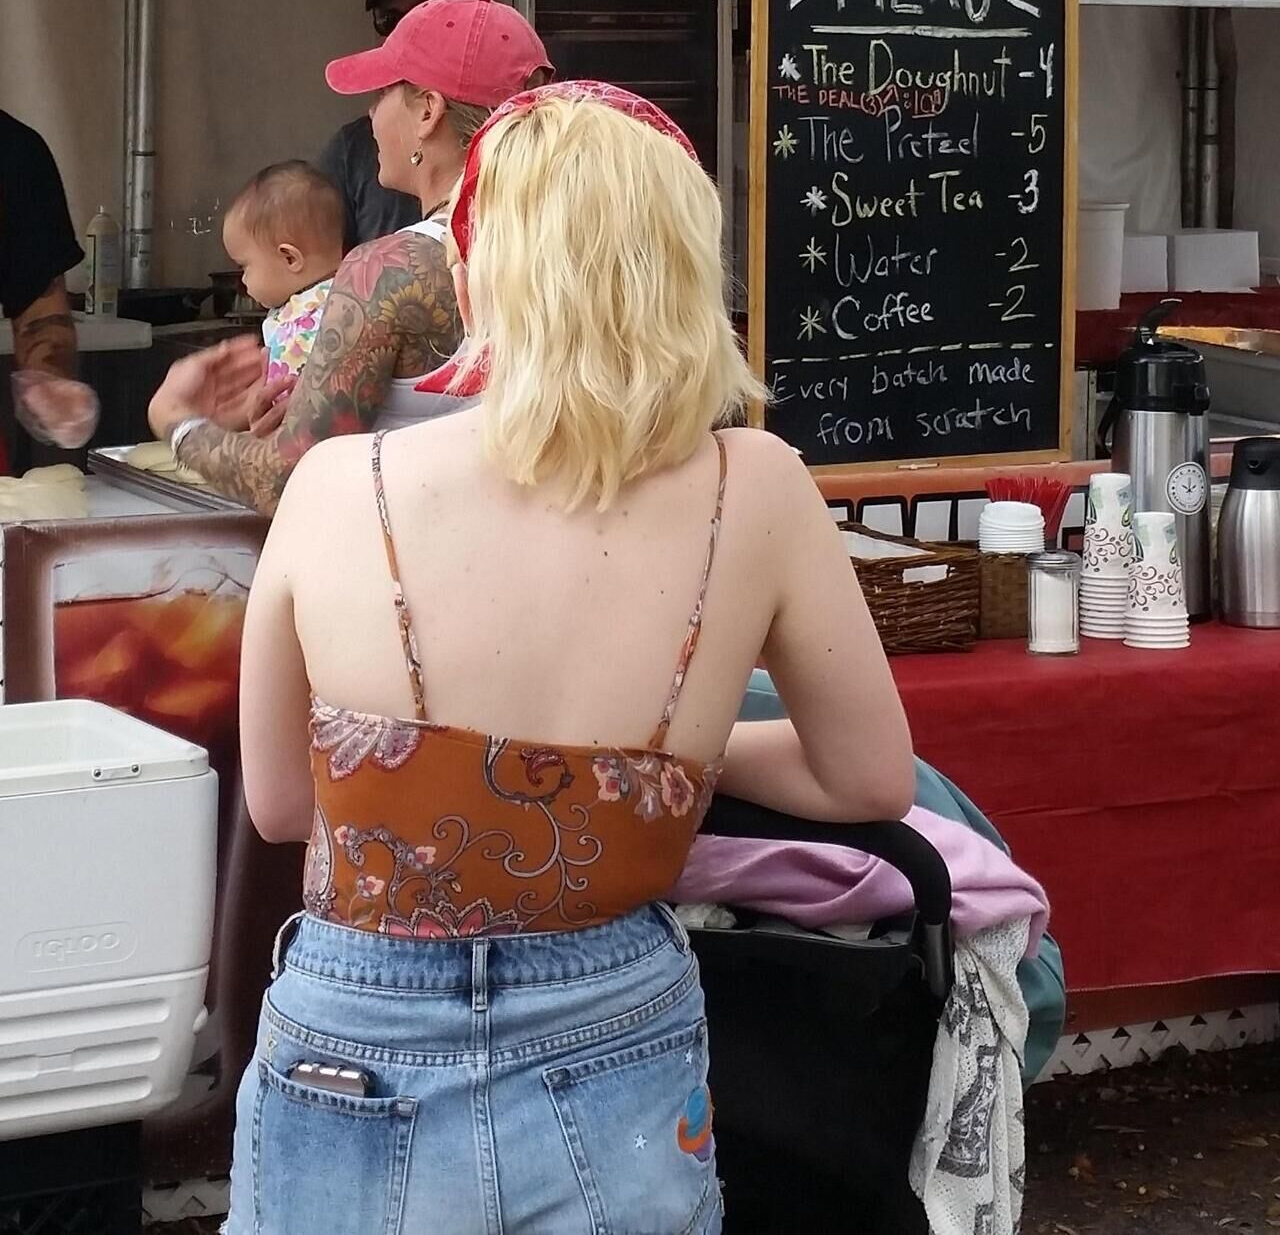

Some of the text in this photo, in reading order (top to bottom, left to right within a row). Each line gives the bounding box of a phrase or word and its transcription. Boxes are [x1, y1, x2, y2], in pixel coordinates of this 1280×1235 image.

[772, 85, 811, 104] THE
[802, 44, 856, 86] The
[869, 38, 1013, 115] Doughnut
[797, 116, 865, 163] The
[877, 104, 980, 163] Pretzel
[831, 171, 926, 227] Sweet
[928, 169, 983, 213] Tea
[834, 232, 938, 288] Water
[831, 291, 935, 341] Coffee
[771, 357, 1036, 405] Every batch made
[816, 397, 1032, 446] from scratch
